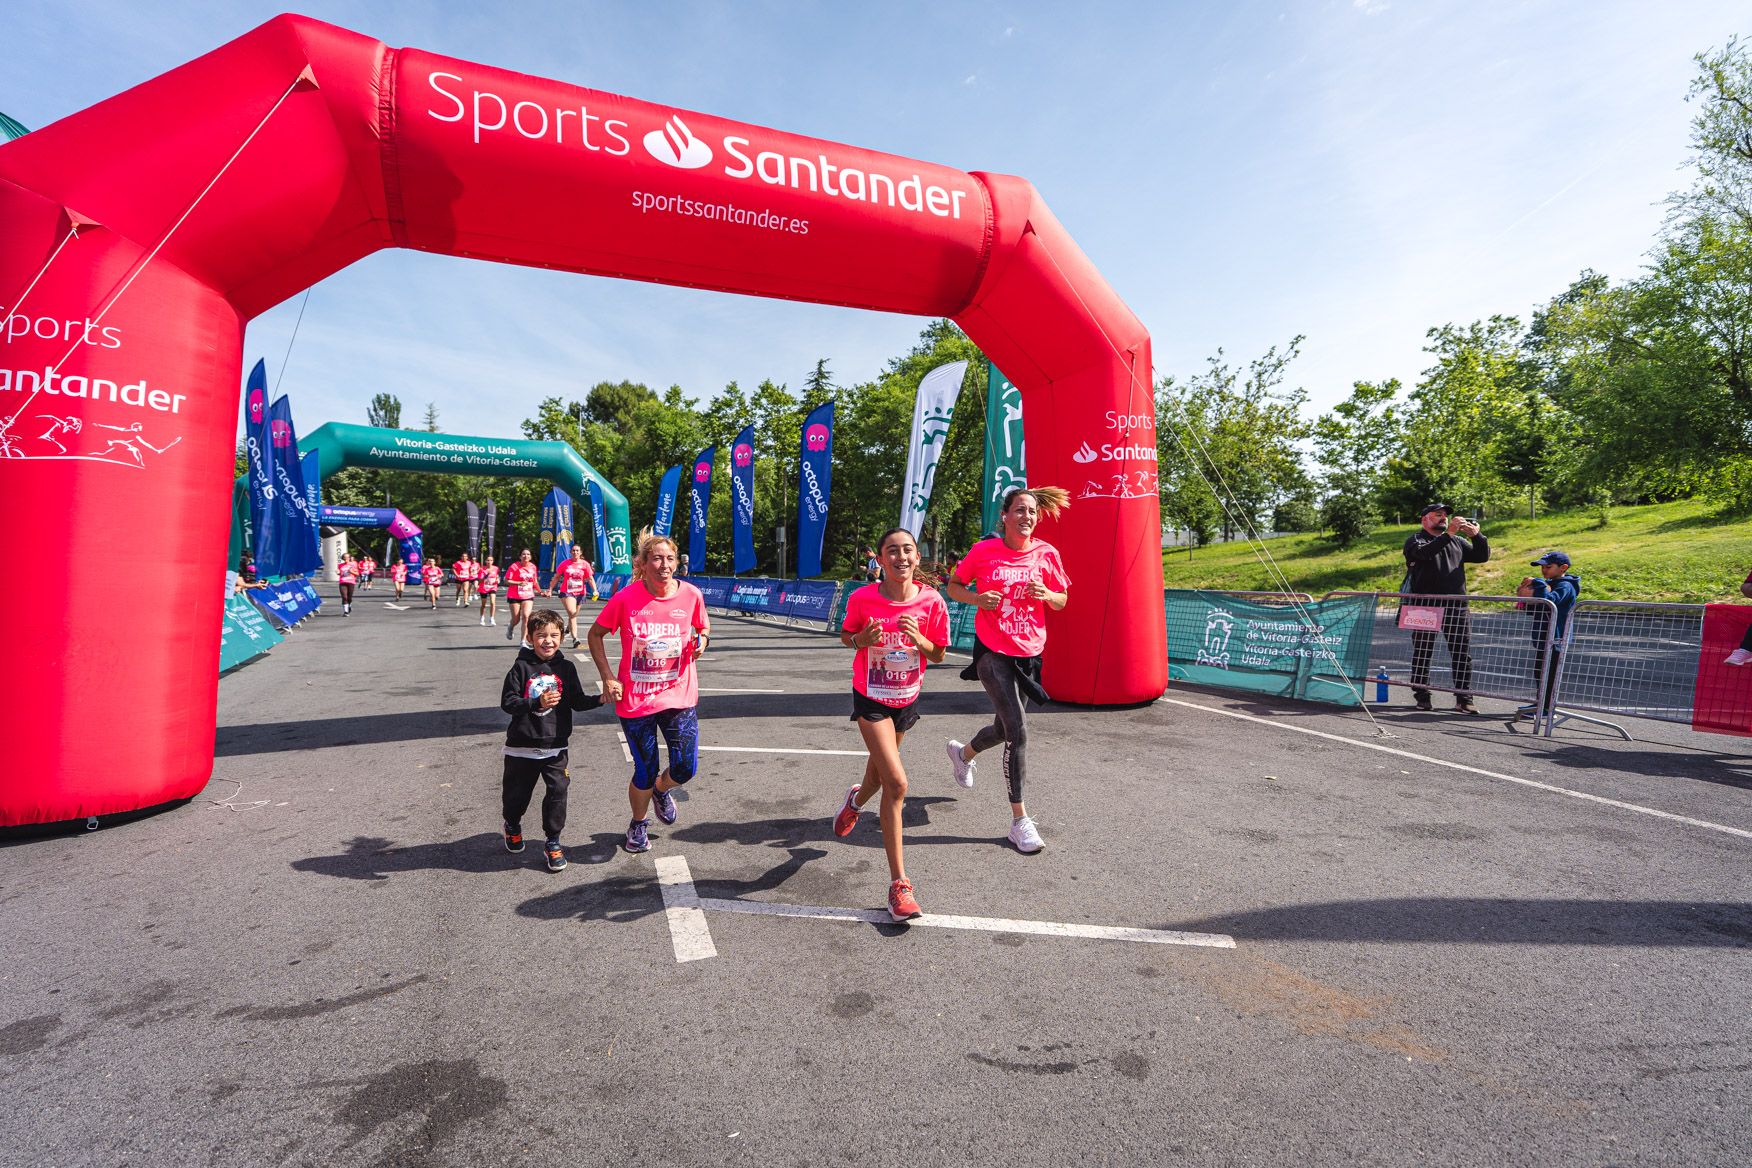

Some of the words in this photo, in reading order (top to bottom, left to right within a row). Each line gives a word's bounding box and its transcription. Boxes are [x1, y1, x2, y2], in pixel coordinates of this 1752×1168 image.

[428, 71, 631, 155] Sports
[724, 136, 967, 219] Santander
[632, 190, 809, 235] sportssantander.es
[0, 304, 122, 349] ports
[0, 366, 187, 413] antander
[1105, 410, 1153, 433] Sports
[395, 437, 485, 453] Vitoria-Gasteizko
[488, 445, 517, 455] Udala
[1100, 443, 1158, 462] Santand
[369, 446, 448, 462] Ayuntamiento
[450, 454, 463, 463] de
[466, 455, 538, 468] Vitoria-Gasteiz
[803, 461, 829, 514] octopus
[804, 496, 819, 521] energy
[992, 568, 1035, 583] CARRERA
[1013, 585, 1028, 600] DE
[634, 623, 681, 636] CARRERA
[1246, 631, 1259, 640] de
[1261, 632, 1343, 646] Vitoria-Gasteiz
[1241, 654, 1271, 666] Udala
[1243, 643, 1337, 660] Vitoria-Gasteizko
[648, 659, 666, 667] 016
[886, 670, 907, 680] 016
